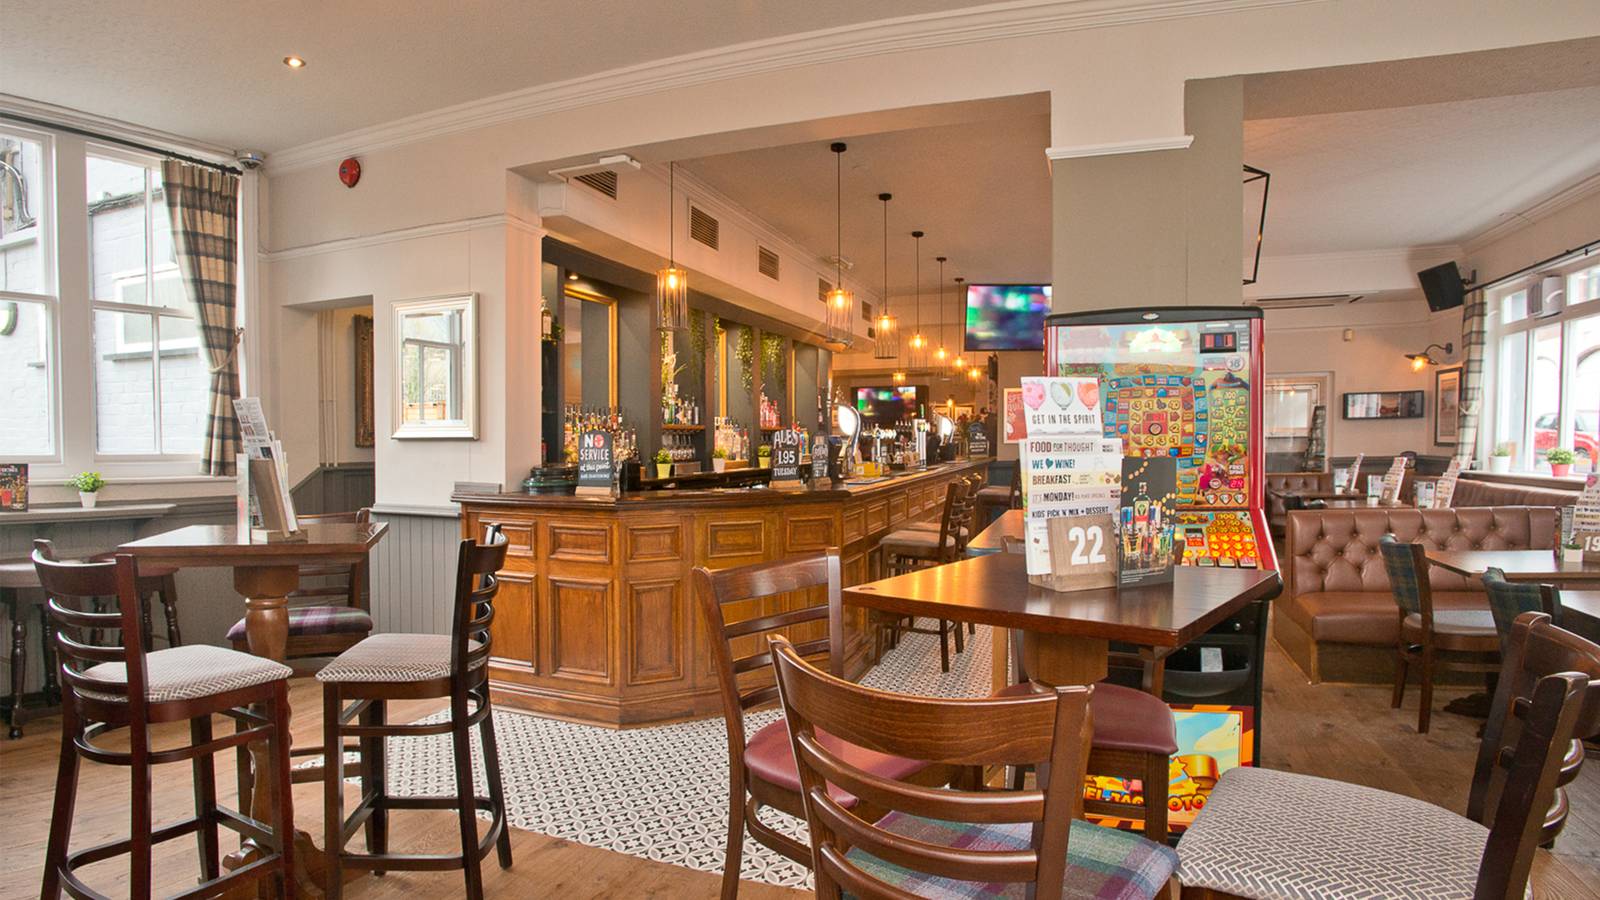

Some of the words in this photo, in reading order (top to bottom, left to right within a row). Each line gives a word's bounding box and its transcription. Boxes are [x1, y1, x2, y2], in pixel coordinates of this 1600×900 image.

[1032, 415, 1045, 425] GET
[1048, 415, 1056, 424] IN
[1059, 415, 1071, 424] THE
[1074, 415, 1095, 425] SPIRIT
[584, 434, 605, 449] NO
[774, 430, 799, 449] ALES
[1030, 442, 1052, 453] FOOD
[1064, 442, 1094, 452] THOUGHT
[580, 449, 609, 460] SERVICE
[596, 461, 610, 472] point
[1032, 460, 1043, 469] WE
[1055, 459, 1075, 469] WINE!
[773, 467, 797, 477] TUESDAY
[1032, 475, 1071, 485] BREAKFAST
[1043, 492, 1074, 502] MONDAY!
[1032, 510, 1045, 518] KIDS
[1047, 509, 1060, 517] PICK
[1069, 508, 1079, 516] MIX
[1085, 506, 1109, 515] DESSERT
[1068, 525, 1106, 566] 22
